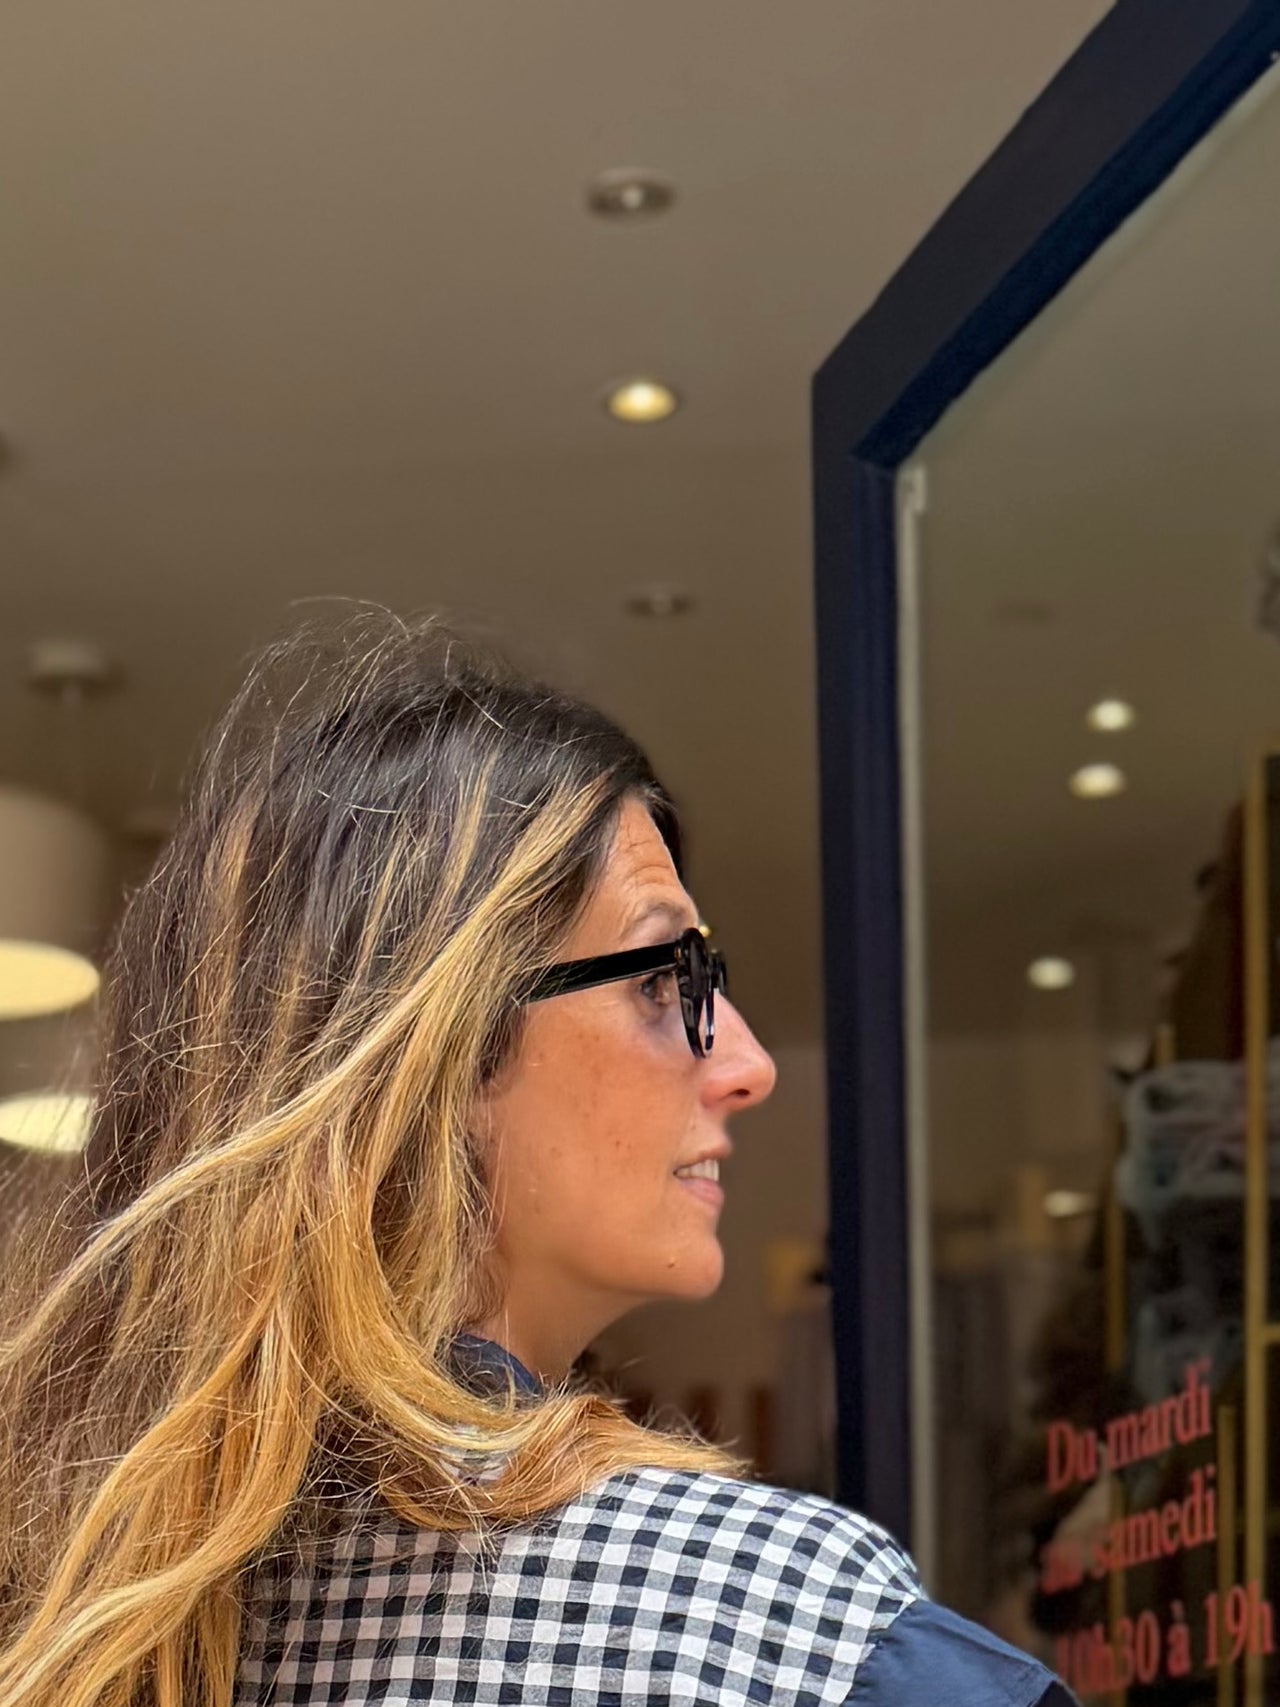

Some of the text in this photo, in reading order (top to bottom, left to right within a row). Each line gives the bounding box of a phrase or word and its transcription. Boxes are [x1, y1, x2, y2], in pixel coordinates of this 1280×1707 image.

[1047, 1357, 1212, 1492] Du mardi
[1091, 1465, 1216, 1579] samedi
[1167, 1601, 1191, 1677] à
[1205, 1579, 1274, 1667] 19h
